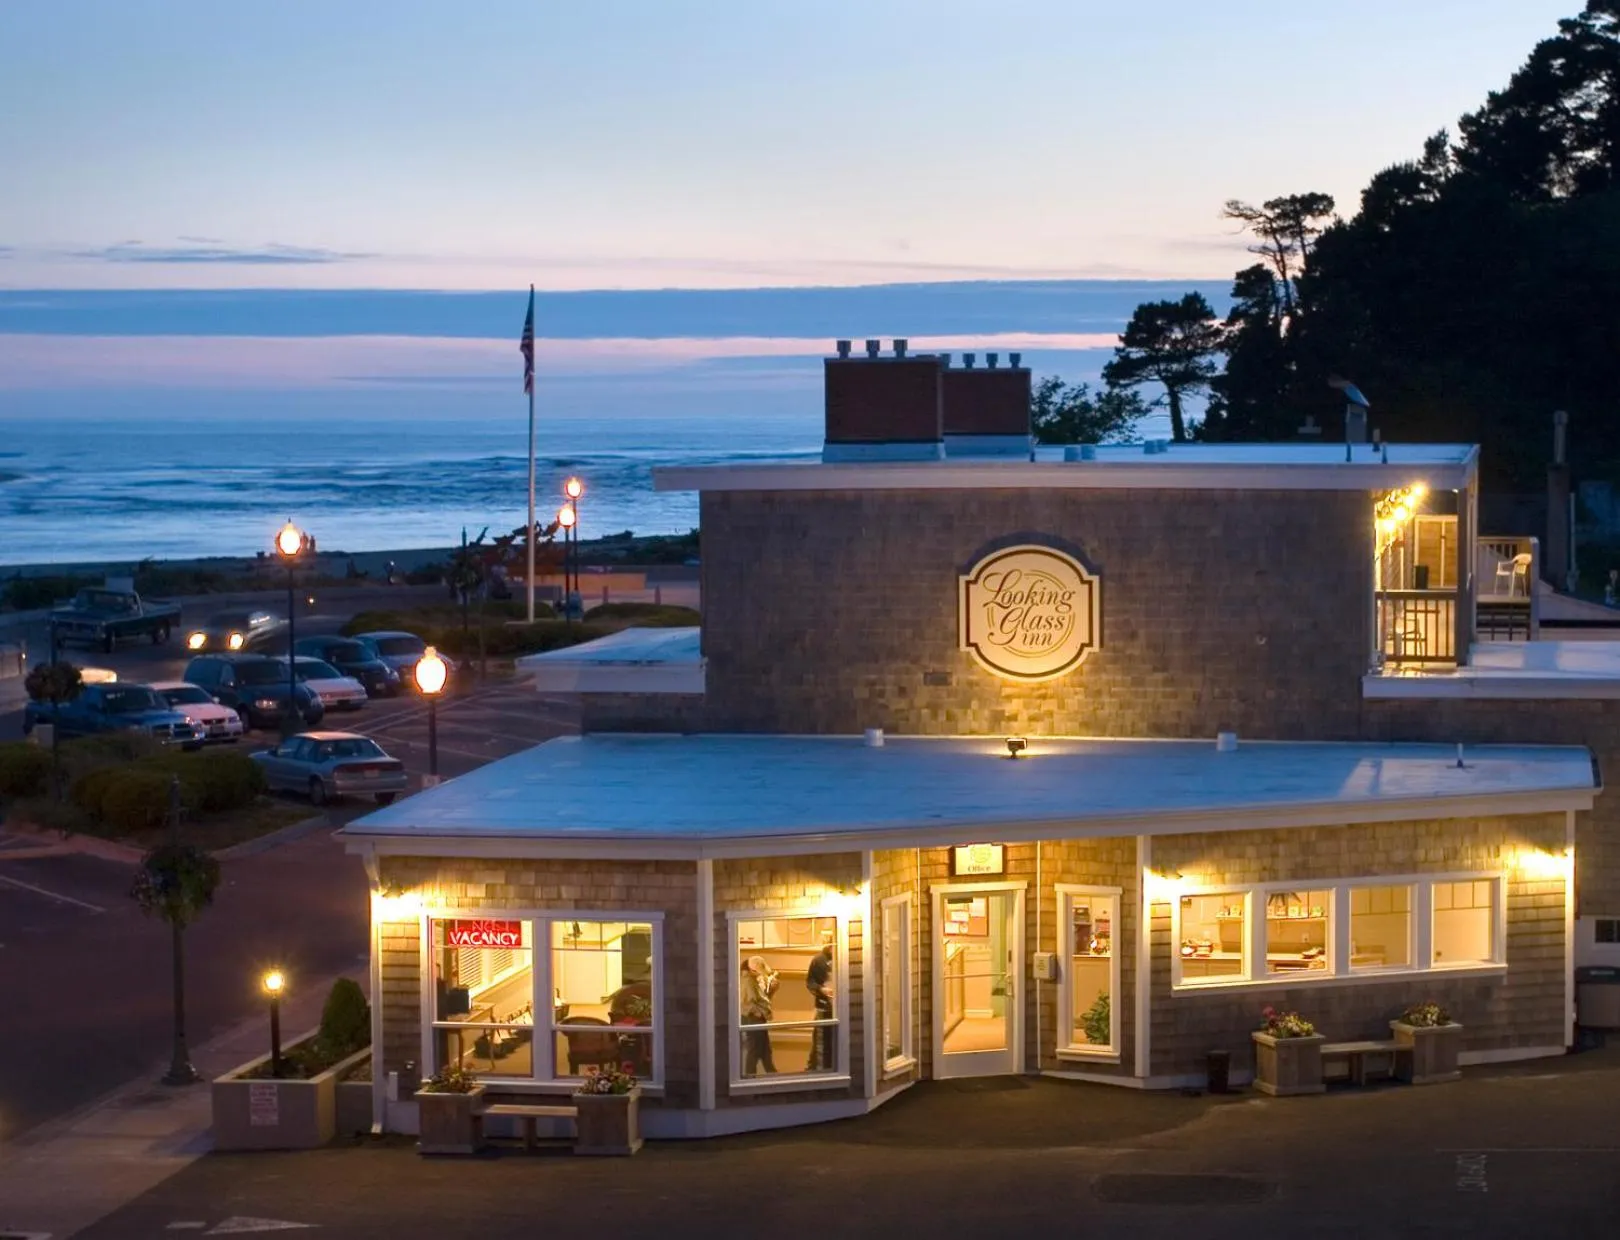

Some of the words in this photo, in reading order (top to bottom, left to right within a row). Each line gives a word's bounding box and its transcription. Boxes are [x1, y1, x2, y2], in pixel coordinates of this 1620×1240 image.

[983, 569, 1076, 613] Looking
[988, 604, 1065, 645] Glass
[967, 864, 992, 873] Office
[449, 931, 518, 945] VACANCY
